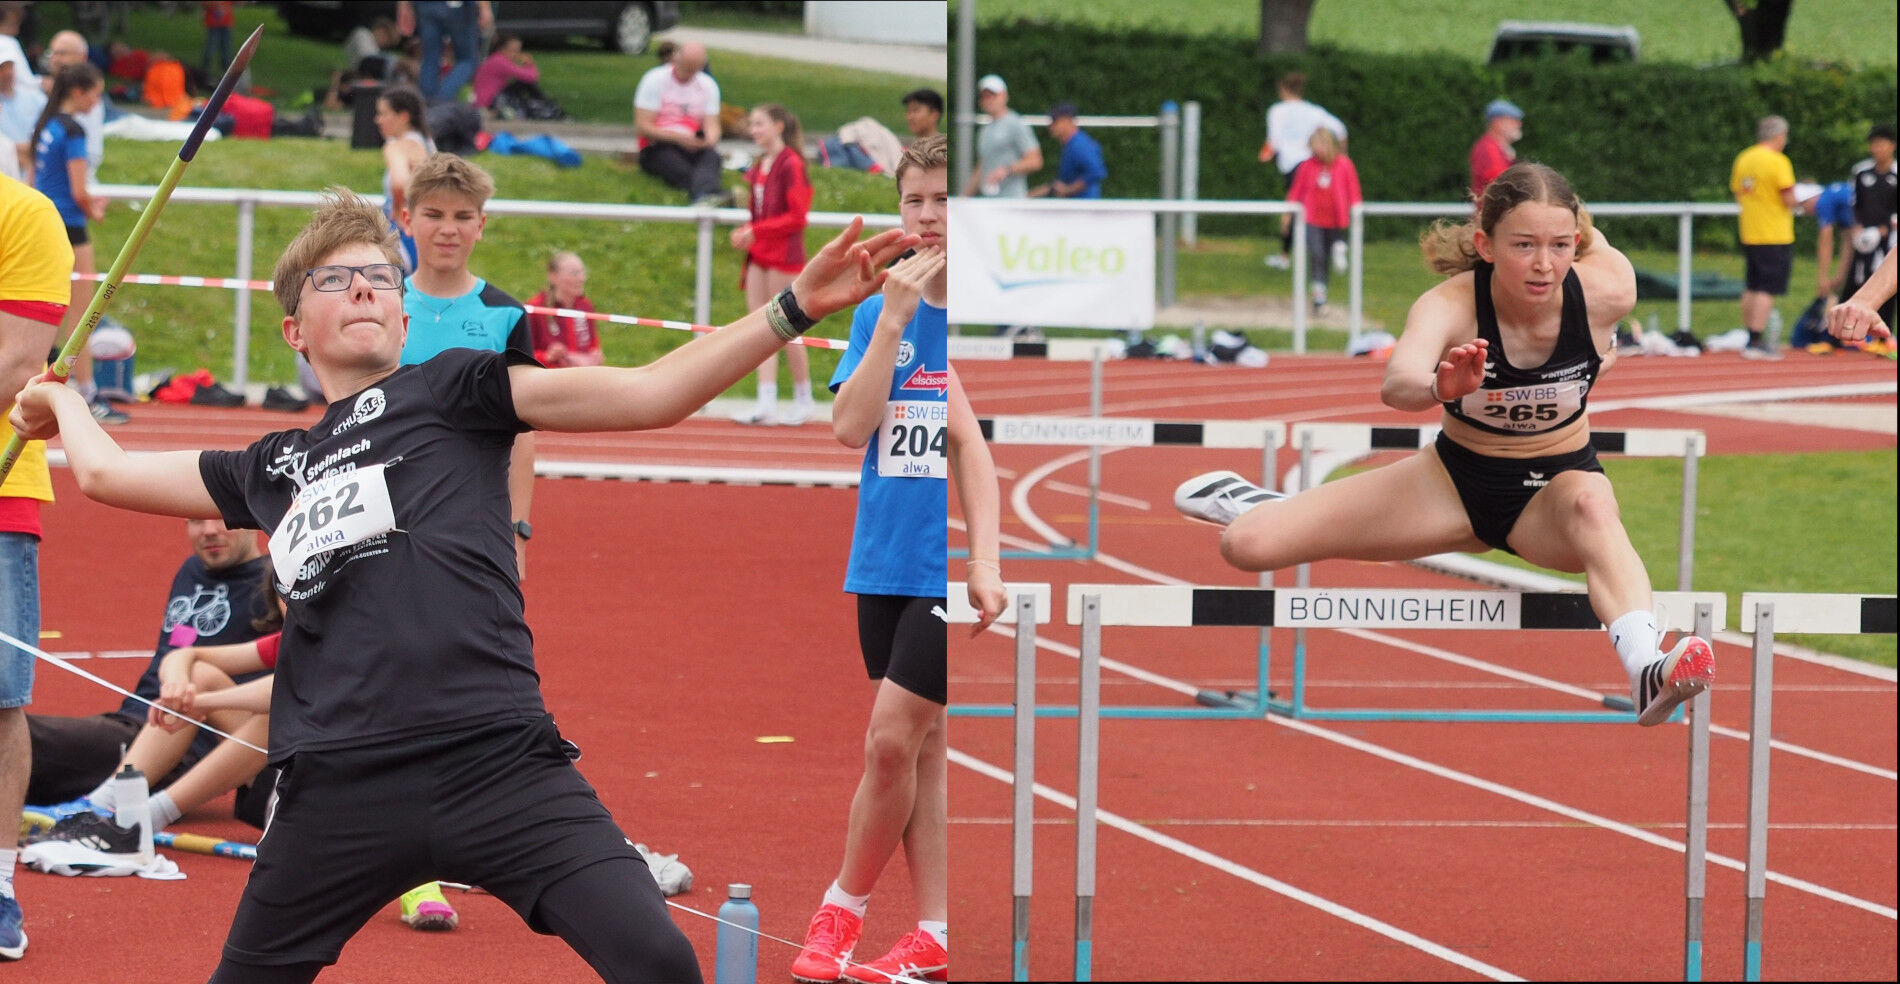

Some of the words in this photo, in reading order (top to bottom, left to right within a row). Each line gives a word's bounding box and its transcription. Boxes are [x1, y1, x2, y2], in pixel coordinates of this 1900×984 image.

[998, 233, 1127, 274] Valeo
[1484, 403, 1559, 422] 265
[890, 424, 947, 458] 204
[307, 439, 371, 481] Steinlach
[903, 461, 930, 473] alwa
[286, 482, 365, 554] 262
[306, 529, 346, 552] alwa
[1290, 592, 1505, 622] BÖNNIGHEIM
